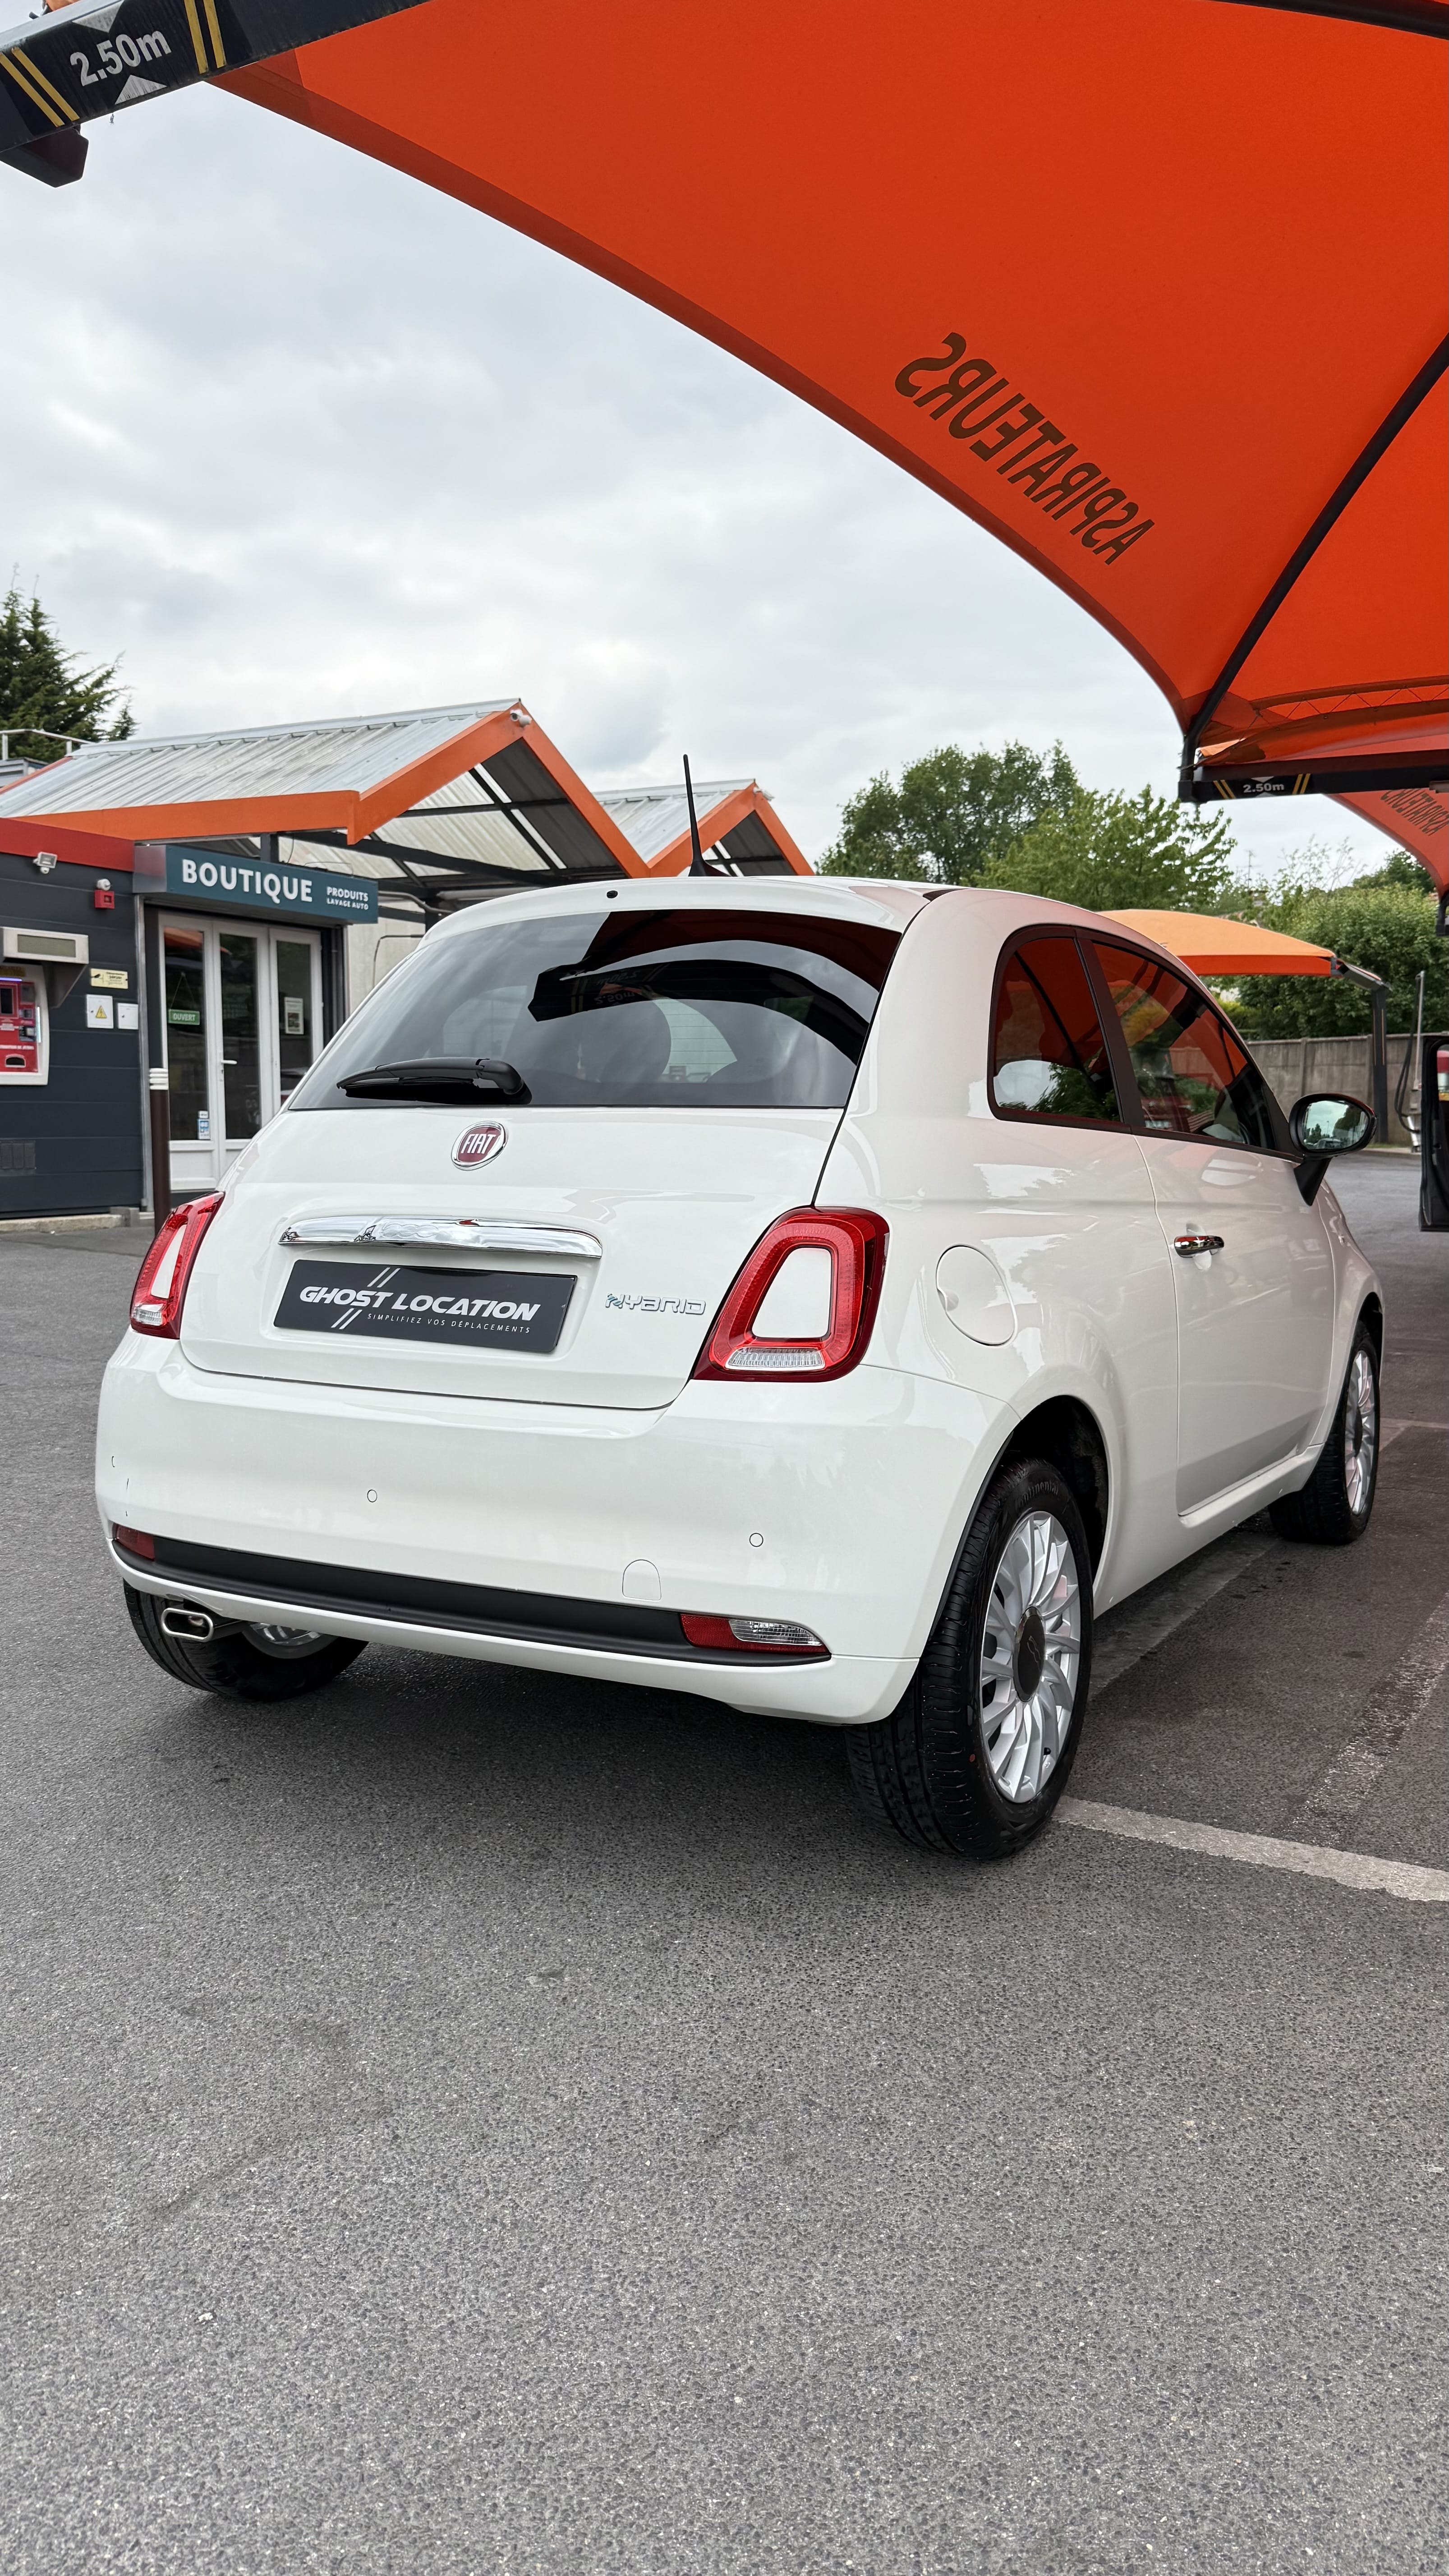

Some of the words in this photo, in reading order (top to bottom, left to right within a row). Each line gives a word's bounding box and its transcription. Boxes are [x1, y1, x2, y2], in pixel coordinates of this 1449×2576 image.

[70, 31, 171, 87] 2.50m
[1243, 783, 1284, 793] 2.50m
[182, 859, 313, 904] BOUTIQUE
[327, 886, 368, 902] PRODUITS
[327, 898, 351, 907] LAVAGE
[352, 902, 369, 910] AUTO
[173, 1013, 196, 1021] OUVERT
[460, 1133, 497, 1154] FIAT
[299, 1286, 394, 1308] GHOST
[391, 1293, 541, 1321] LOCATION
[605, 1293, 706, 1315] HYBRID
[368, 1313, 422, 1324] SIMPLIFIEZ
[451, 1320, 530, 1333] DÉPLACEMENTS
